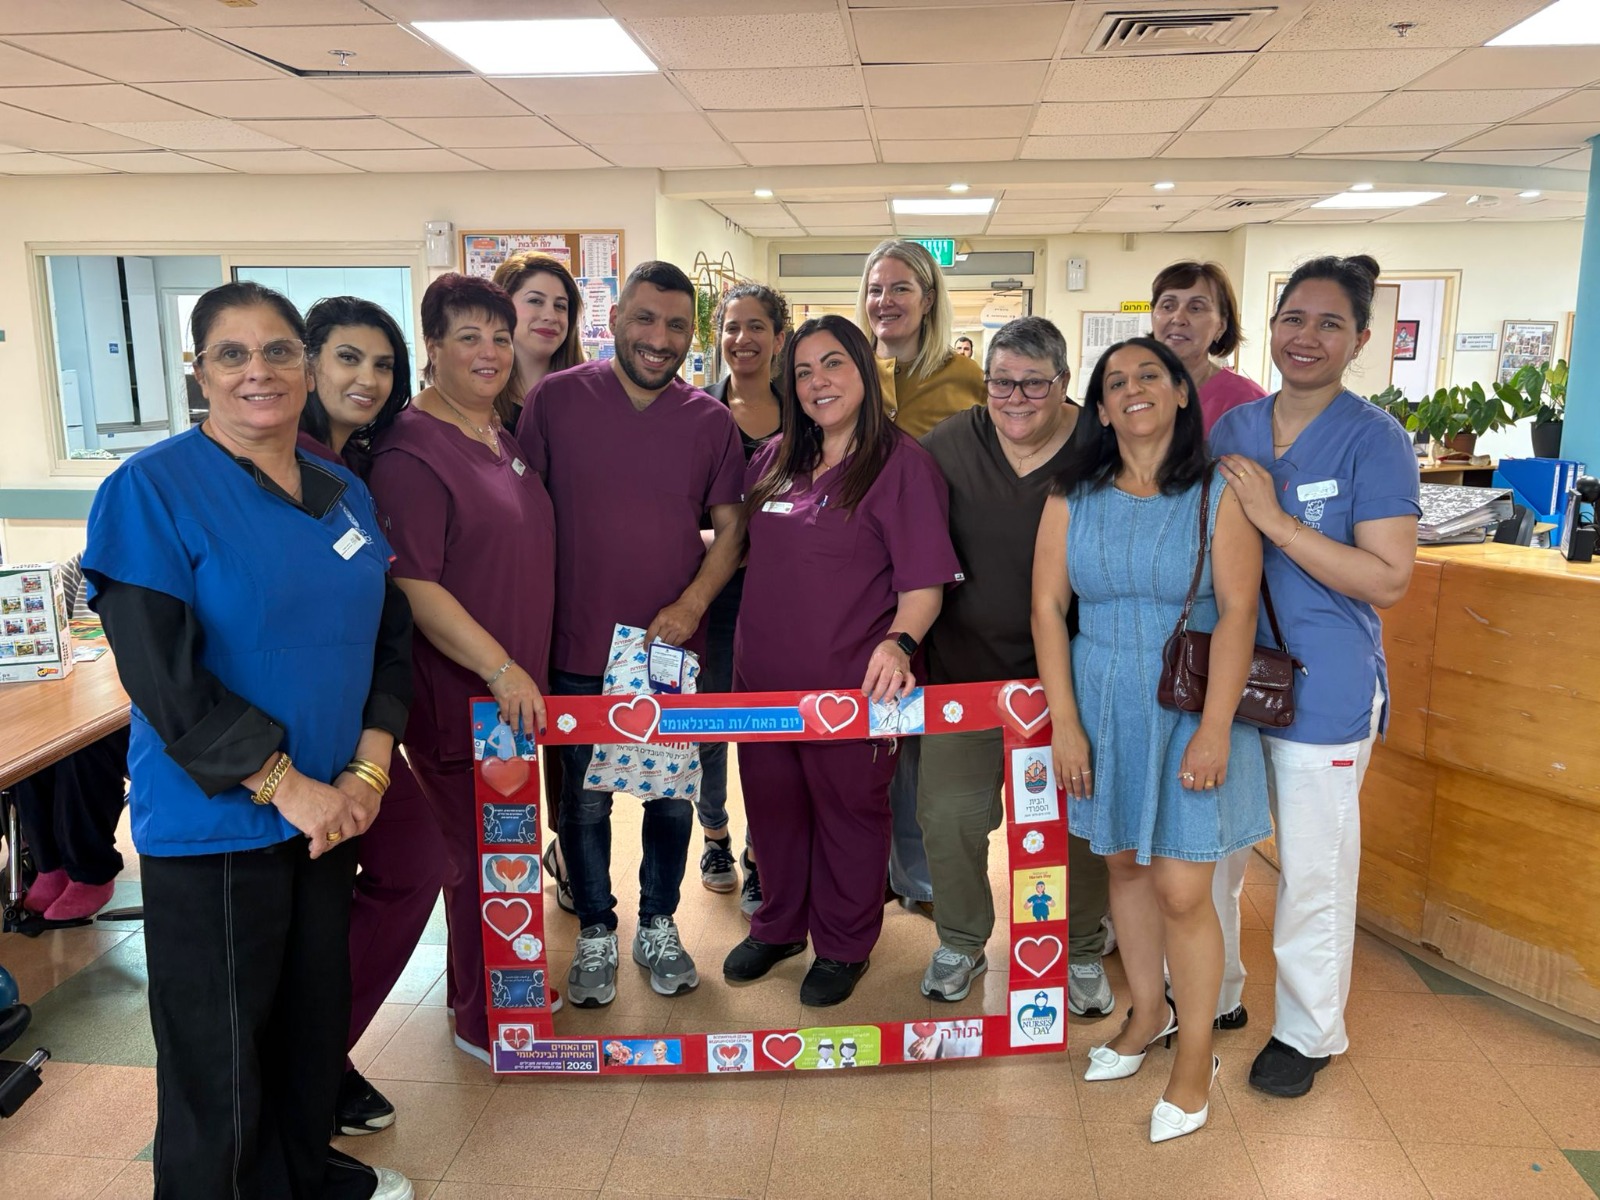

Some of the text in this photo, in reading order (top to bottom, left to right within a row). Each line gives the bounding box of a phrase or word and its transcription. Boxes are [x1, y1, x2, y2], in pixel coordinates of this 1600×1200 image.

[662, 715, 799, 730] יום האח/ות הבינלאומי
[616, 744, 640, 753] בישראל
[640, 748, 665, 757] העובדים
[1029, 797, 1045, 806] הבית
[1026, 804, 1049, 813] הספרדי
[941, 1026, 979, 1039] תודה
[1033, 1027, 1050, 1035] DAY
[551, 1043, 595, 1051] יום האחים
[516, 1050, 595, 1059] והאחיות הבינלאומי
[566, 1061, 593, 1070] 2026
